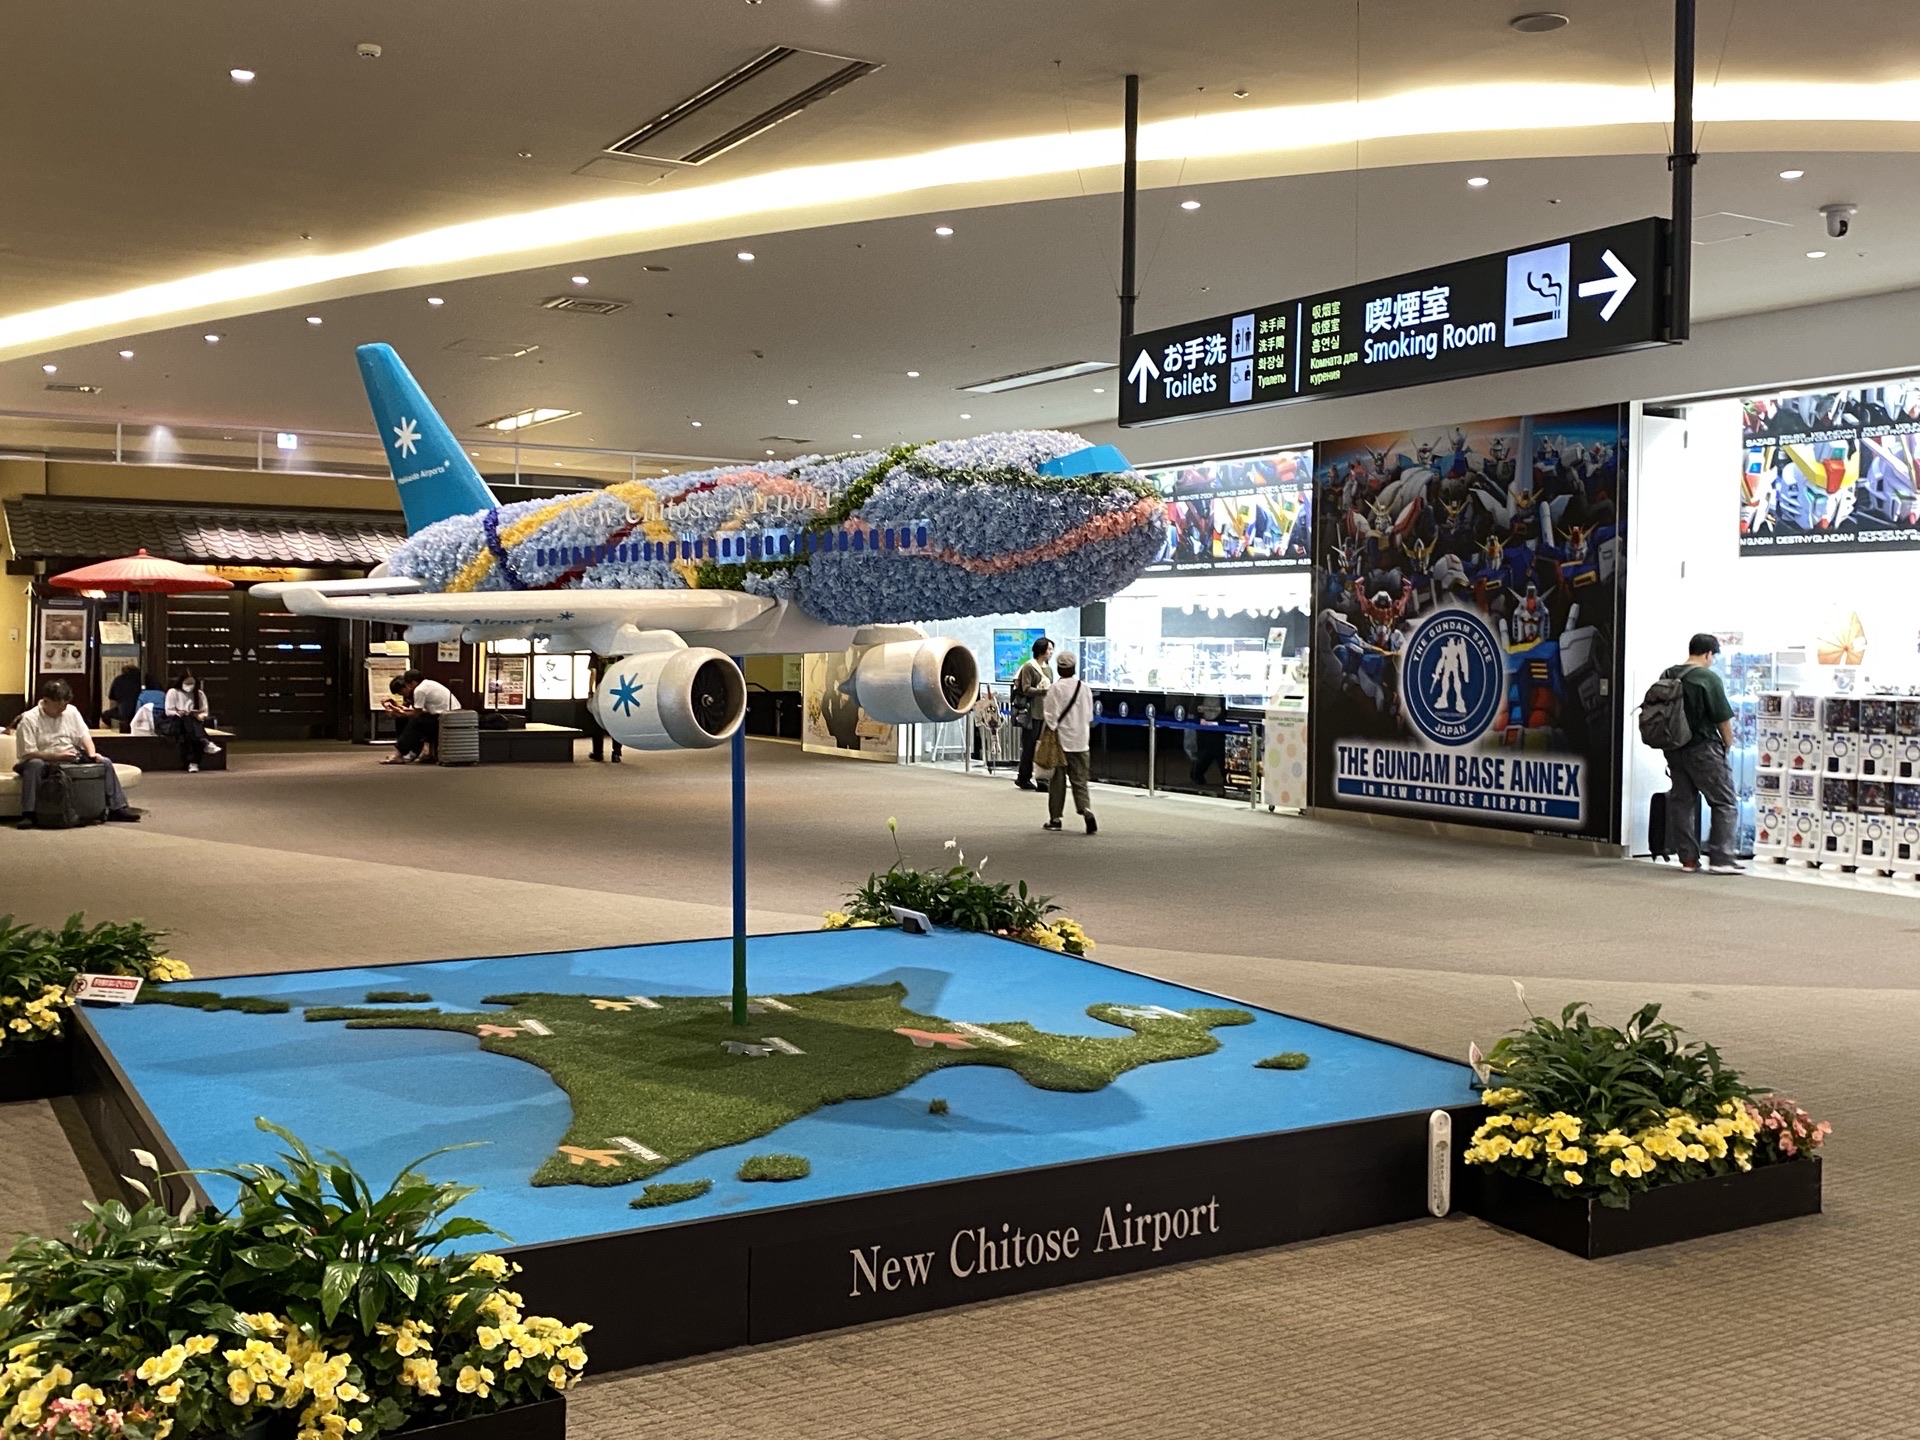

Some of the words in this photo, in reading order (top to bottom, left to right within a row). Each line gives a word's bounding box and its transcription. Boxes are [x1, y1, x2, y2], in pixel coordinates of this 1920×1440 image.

[1259, 317, 1286, 334] 洗手间
[1365, 286, 1450, 334] 喫煙室
[1163, 333, 1227, 373] お手洗
[1258, 354, 1285, 371] 화장실
[1364, 330, 1438, 364] Smoking
[1443, 322, 1496, 350] Room
[1163, 372, 1217, 399] Toilets
[566, 508, 612, 527] New
[625, 498, 716, 524] Chitose
[728, 487, 835, 517] Airport
[1412, 638, 1429, 662] THE
[1428, 621, 1471, 638] GUNDAM
[1472, 631, 1493, 664] BASE
[1435, 723, 1468, 736] JAPAN
[1338, 746, 1369, 777] THE
[1373, 748, 1451, 785] GUNDAM
[1455, 756, 1506, 790] BASE
[1510, 760, 1580, 798] ANNEX
[1382, 785, 1408, 800] NEW
[1415, 788, 1475, 807] CHITOSE
[1482, 795, 1548, 815] AIRPORT
[849, 1245, 936, 1298] New
[949, 1222, 1080, 1278] Chitose
[1093, 1195, 1221, 1252] Airport
